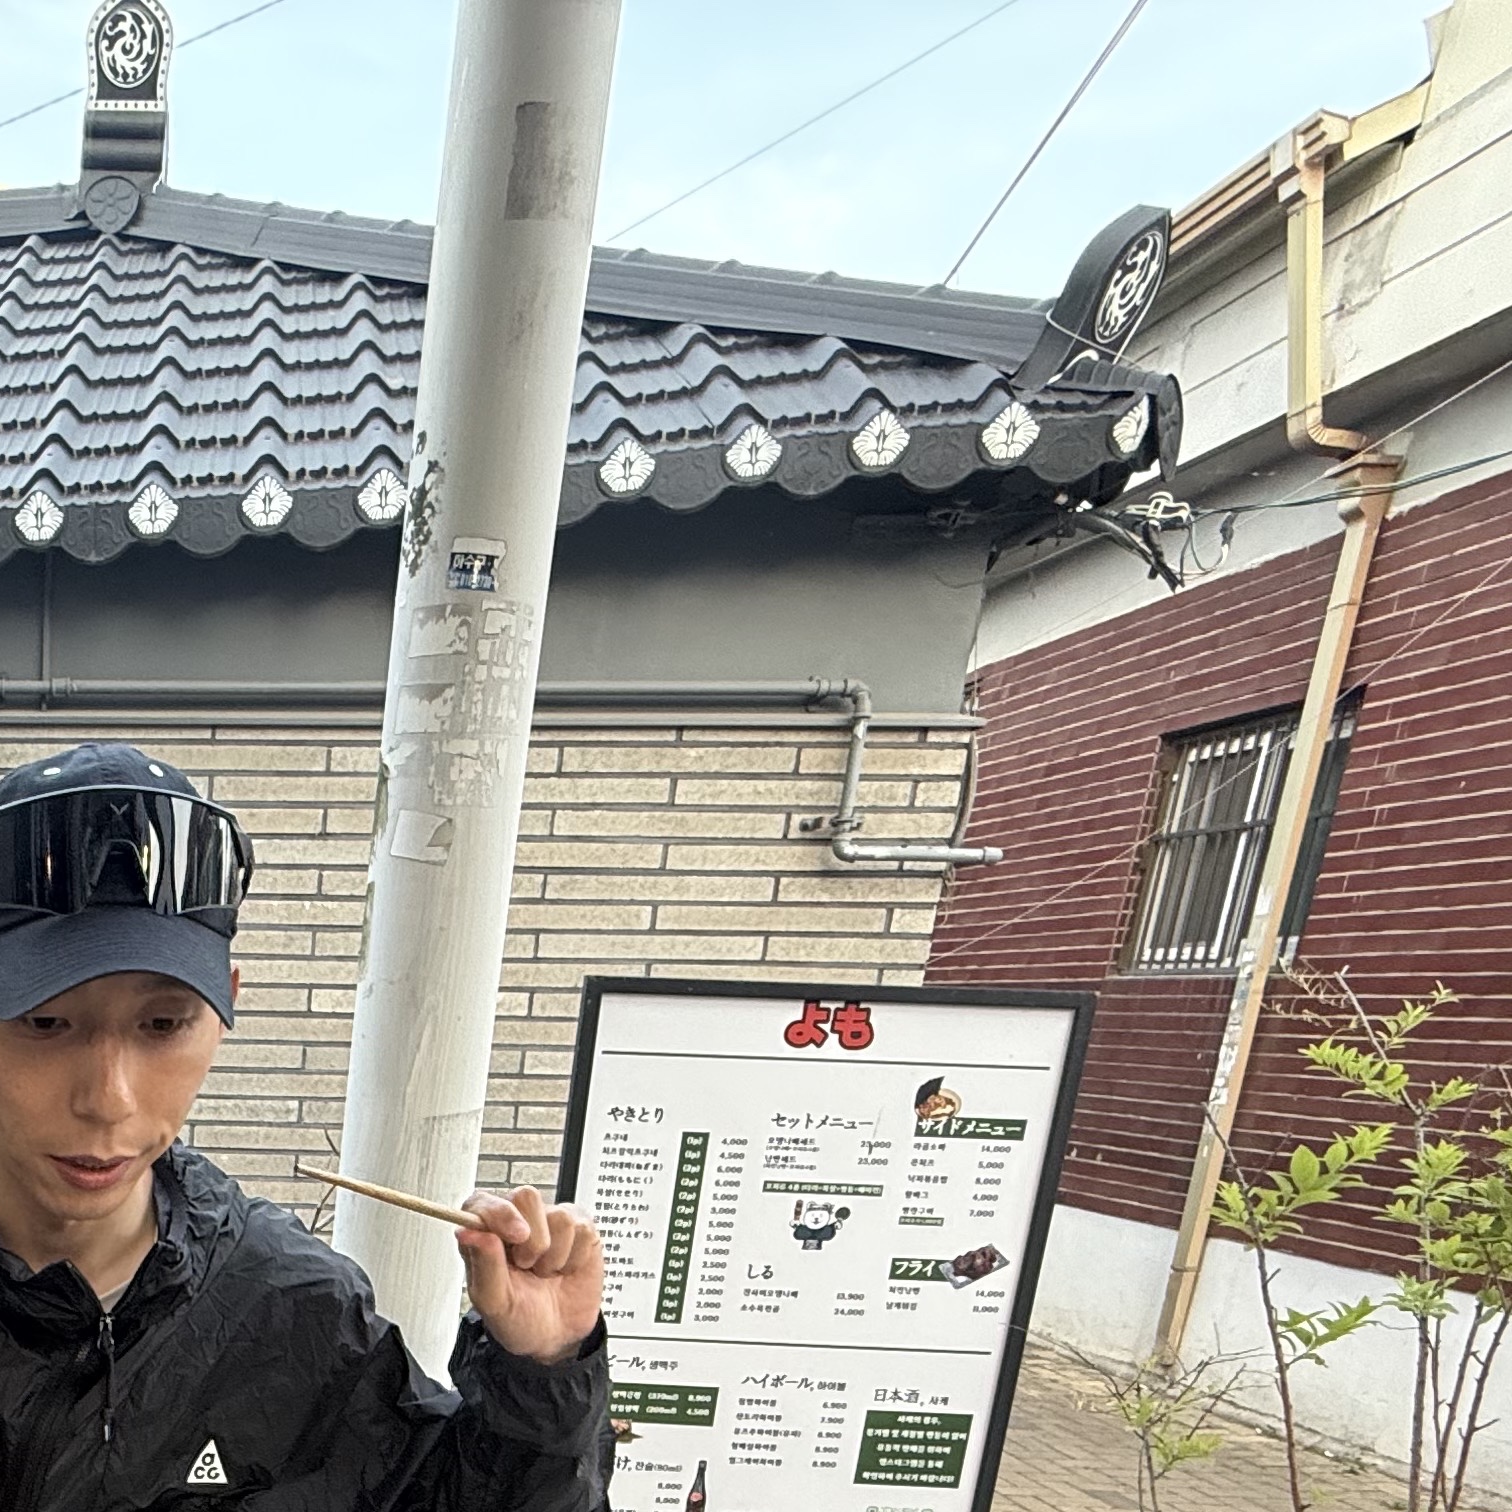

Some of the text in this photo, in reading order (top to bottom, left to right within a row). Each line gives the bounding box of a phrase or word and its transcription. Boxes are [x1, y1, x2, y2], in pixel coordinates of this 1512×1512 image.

[784, 1000, 874, 1051] よも
[607, 1106, 664, 1123] やきとり
[771, 1113, 874, 1129] セットメニュー
[918, 1118, 1022, 1136] サイドメニュー
[748, 1264, 774, 1280] しる
[895, 1261, 936, 1277] フライ
